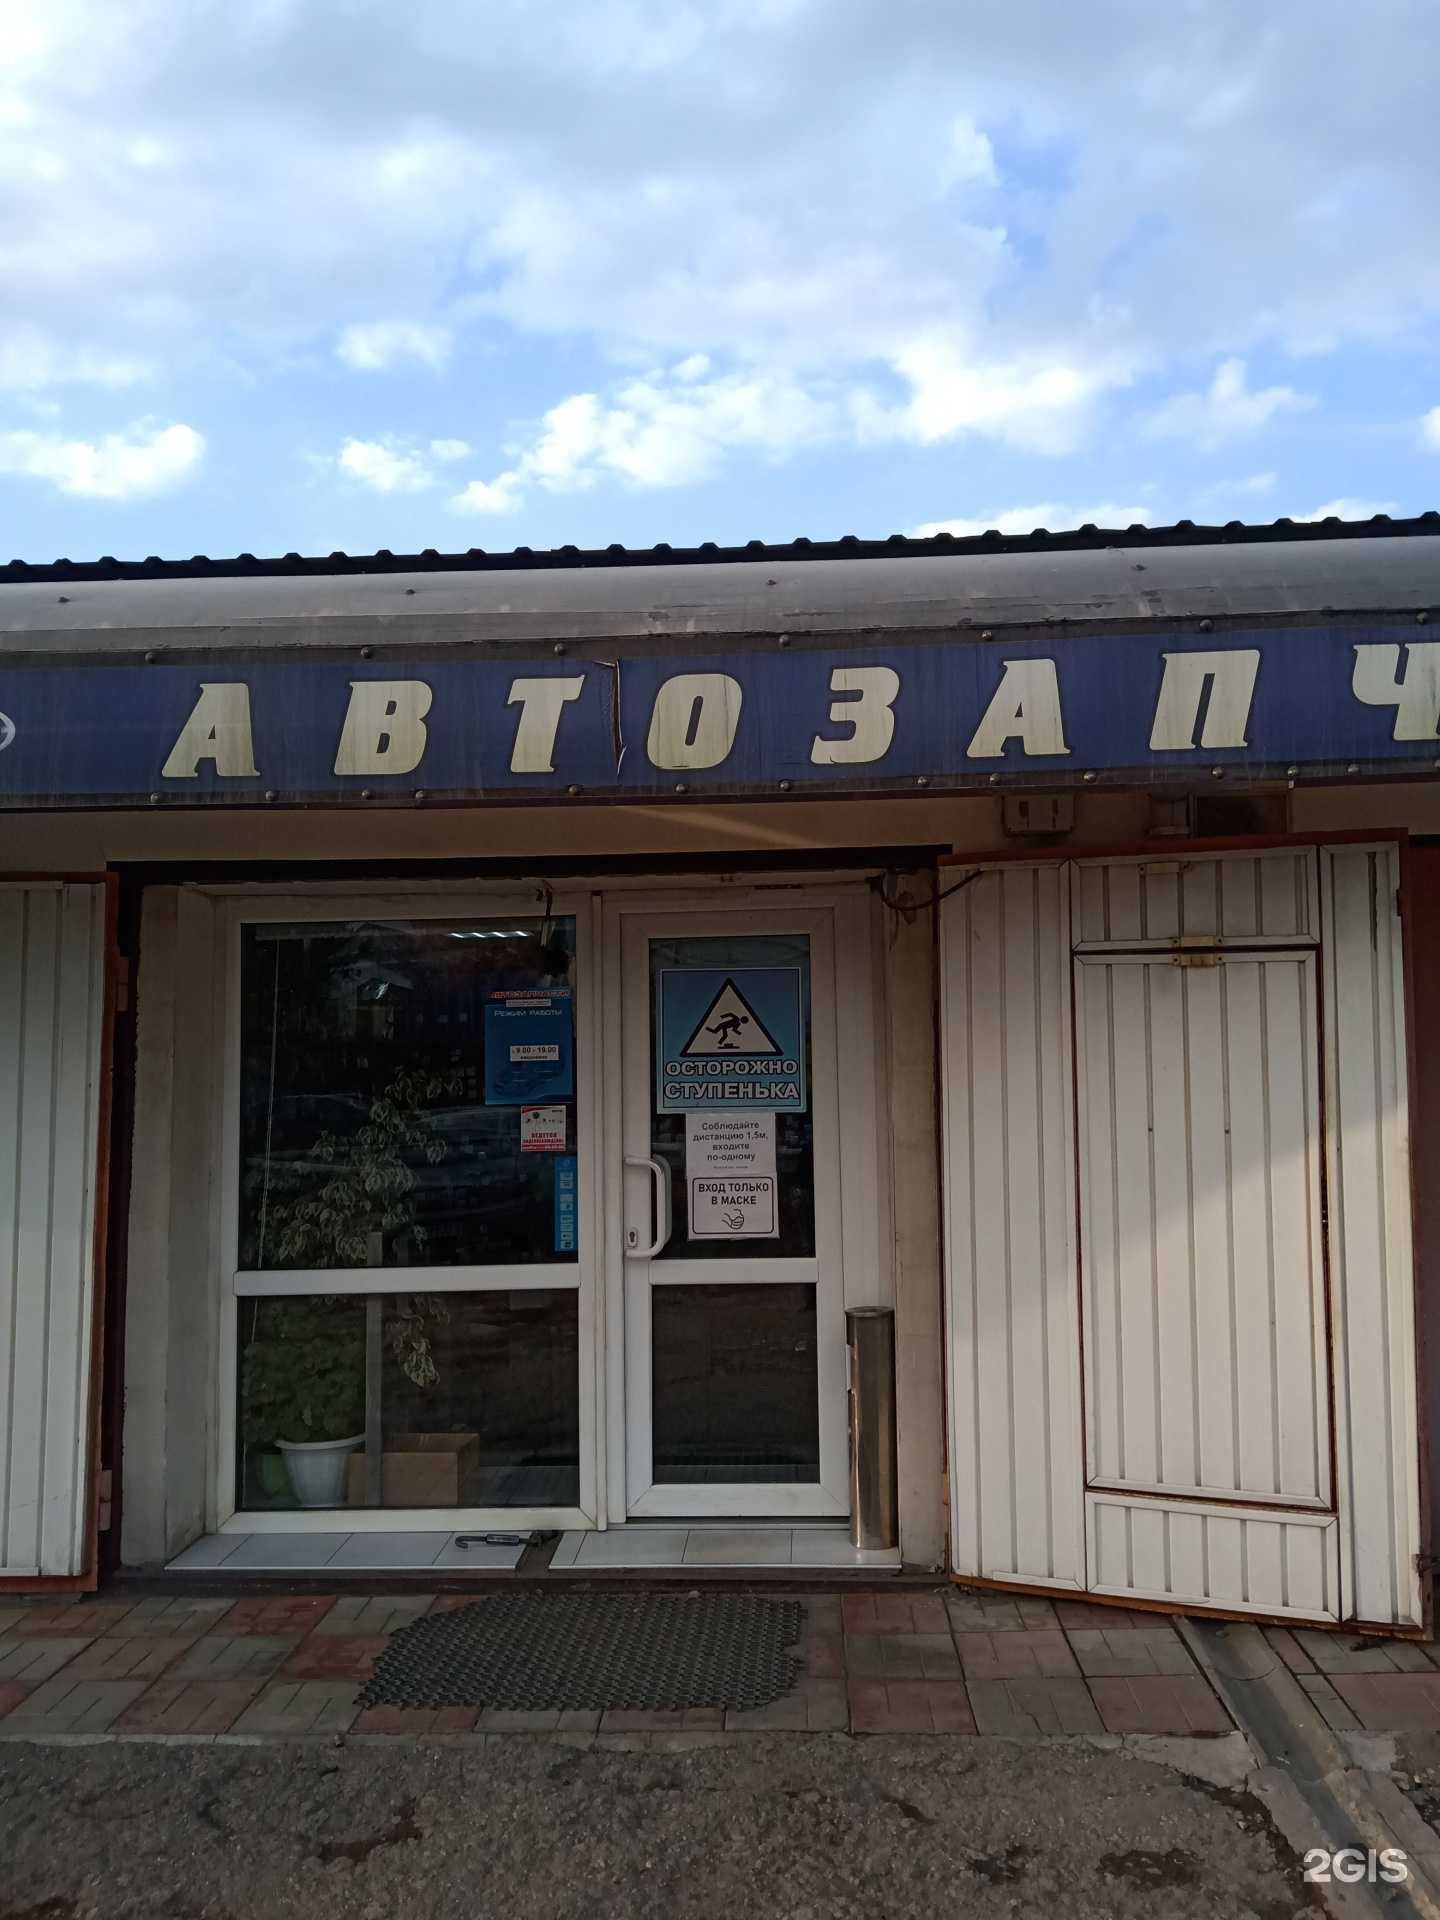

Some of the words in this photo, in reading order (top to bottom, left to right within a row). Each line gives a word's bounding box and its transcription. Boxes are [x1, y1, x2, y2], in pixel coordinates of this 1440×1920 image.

[666, 1060, 798, 1076] ОСТОРОЖНО
[665, 1082, 799, 1099] СТУПЕНЬКА
[701, 1121, 760, 1131] Соблюдайте
[693, 1133, 744, 1142] дистанцию
[712, 1143, 750, 1151] входите
[707, 1153, 755, 1162] по-одному
[698, 1183, 726, 1193] ВХОД
[728, 1182, 769, 1192] ТОЛЬКО
[711, 1196, 718, 1205] В
[721, 1195, 757, 1205] МАСКЕ
